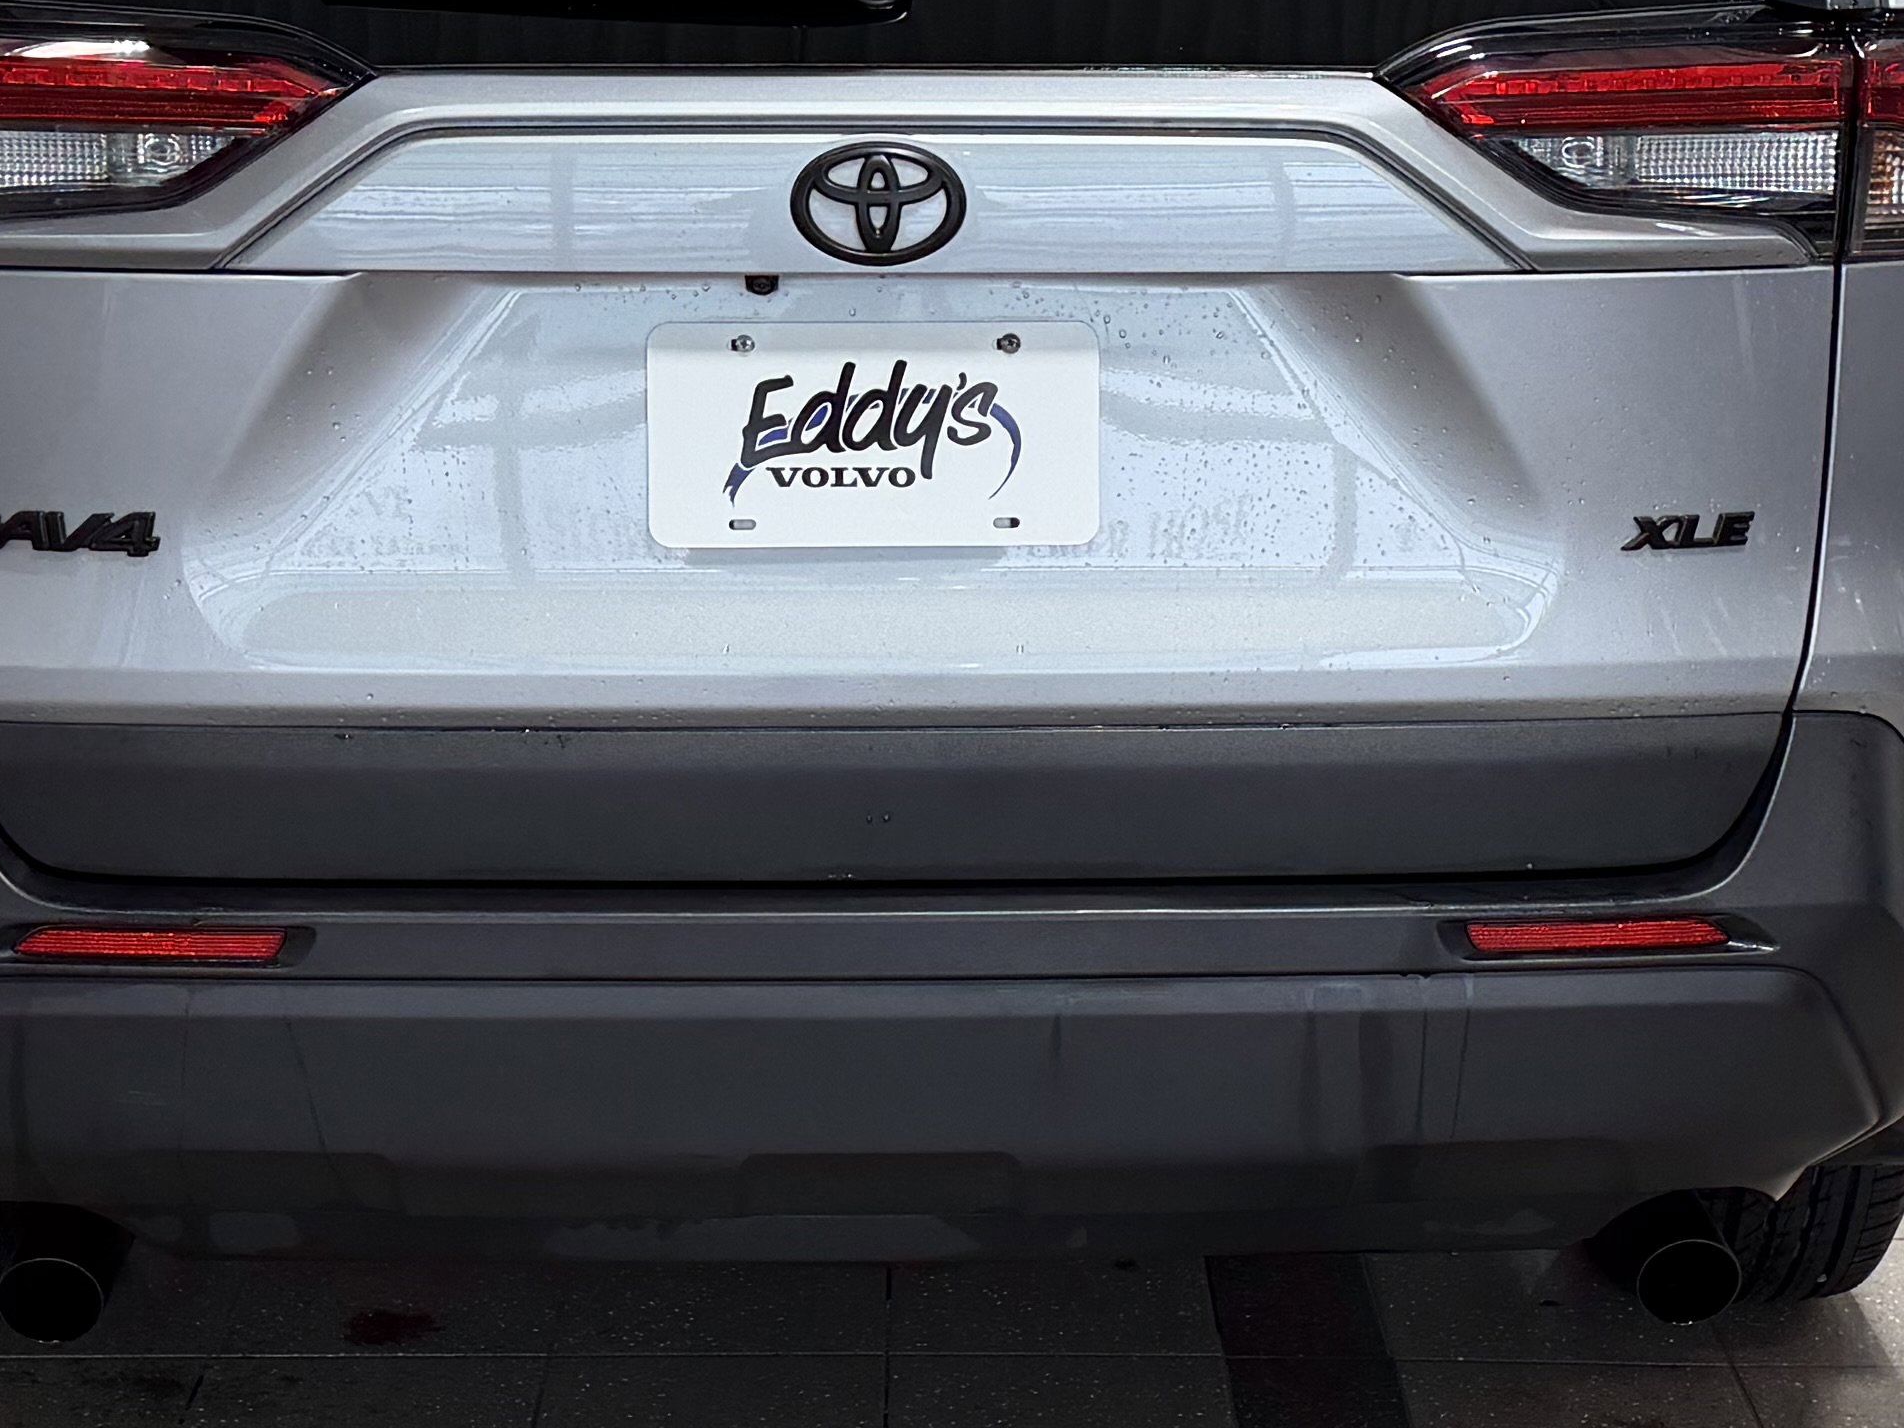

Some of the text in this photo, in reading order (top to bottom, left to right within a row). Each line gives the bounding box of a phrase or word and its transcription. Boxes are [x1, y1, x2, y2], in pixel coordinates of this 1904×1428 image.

[740, 360, 998, 479] Eddy's
[765, 466, 916, 489] VOLVO
[1620, 511, 1755, 551] XLE
